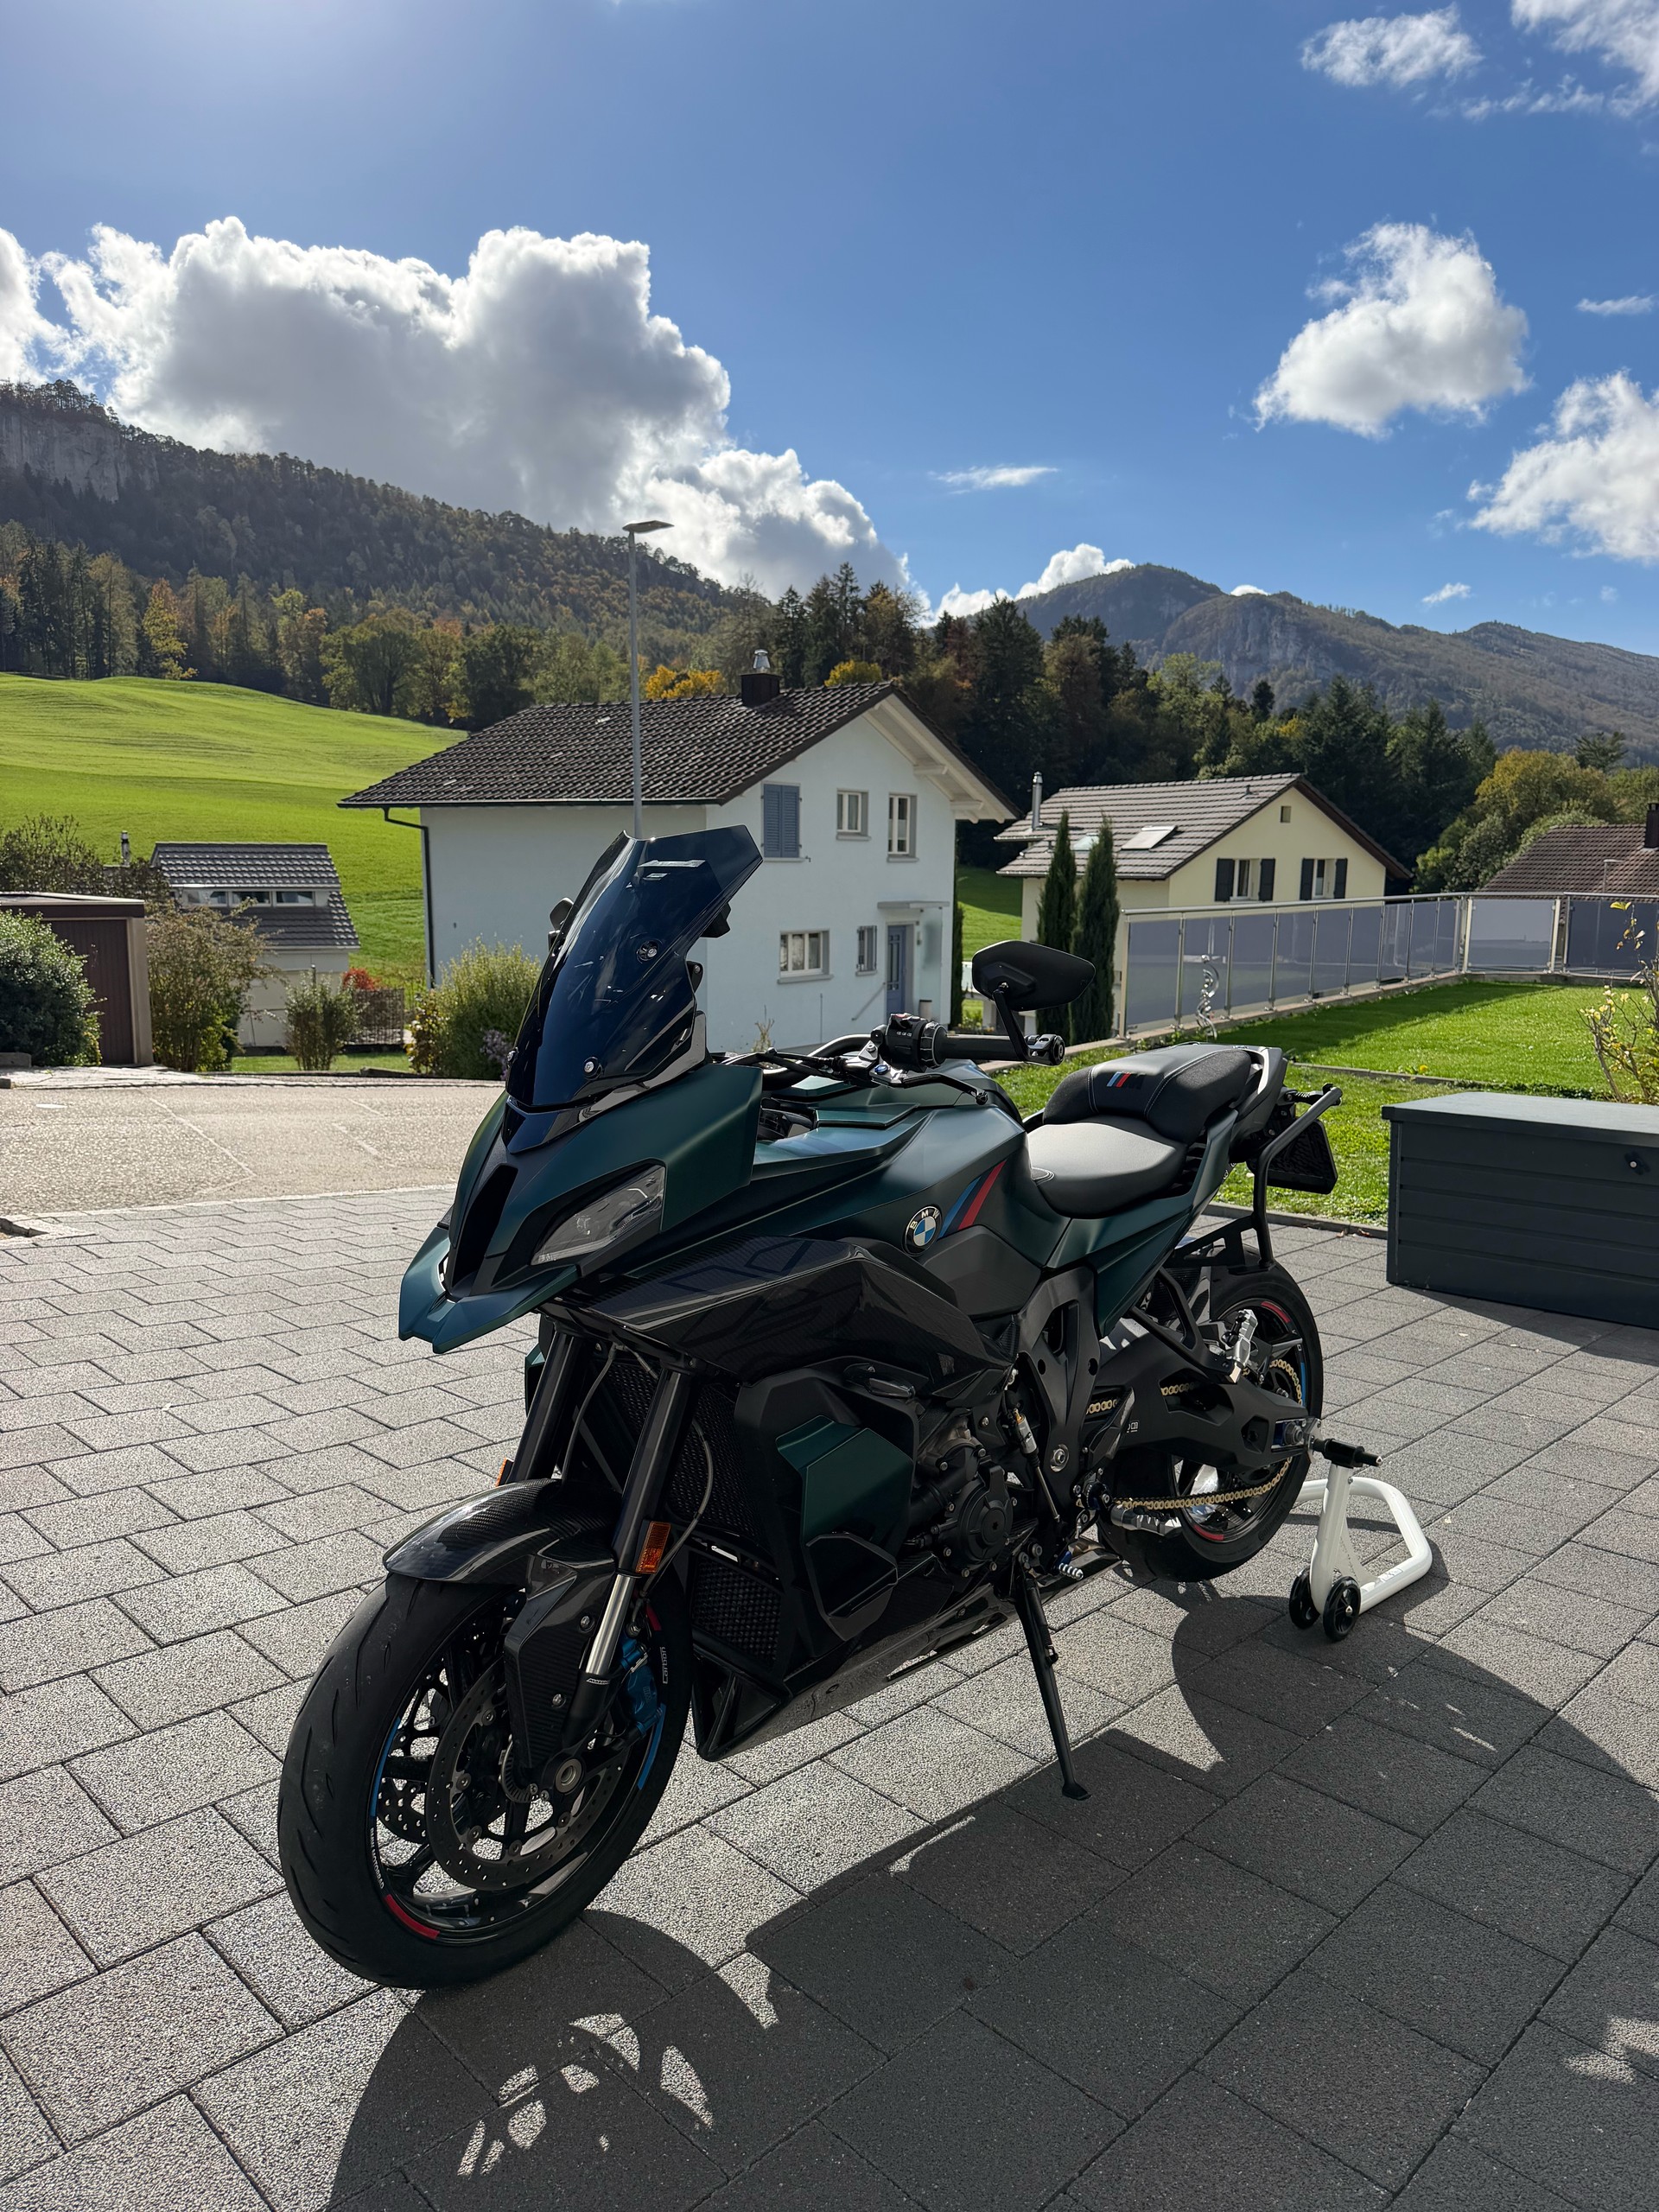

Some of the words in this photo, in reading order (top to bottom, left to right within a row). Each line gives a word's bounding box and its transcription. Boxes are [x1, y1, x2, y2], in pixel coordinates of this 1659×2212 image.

[909, 1209, 940, 1230] BMW
[659, 1646, 668, 1685] Carbon
[372, 1849, 385, 1890] MOTORRAD
